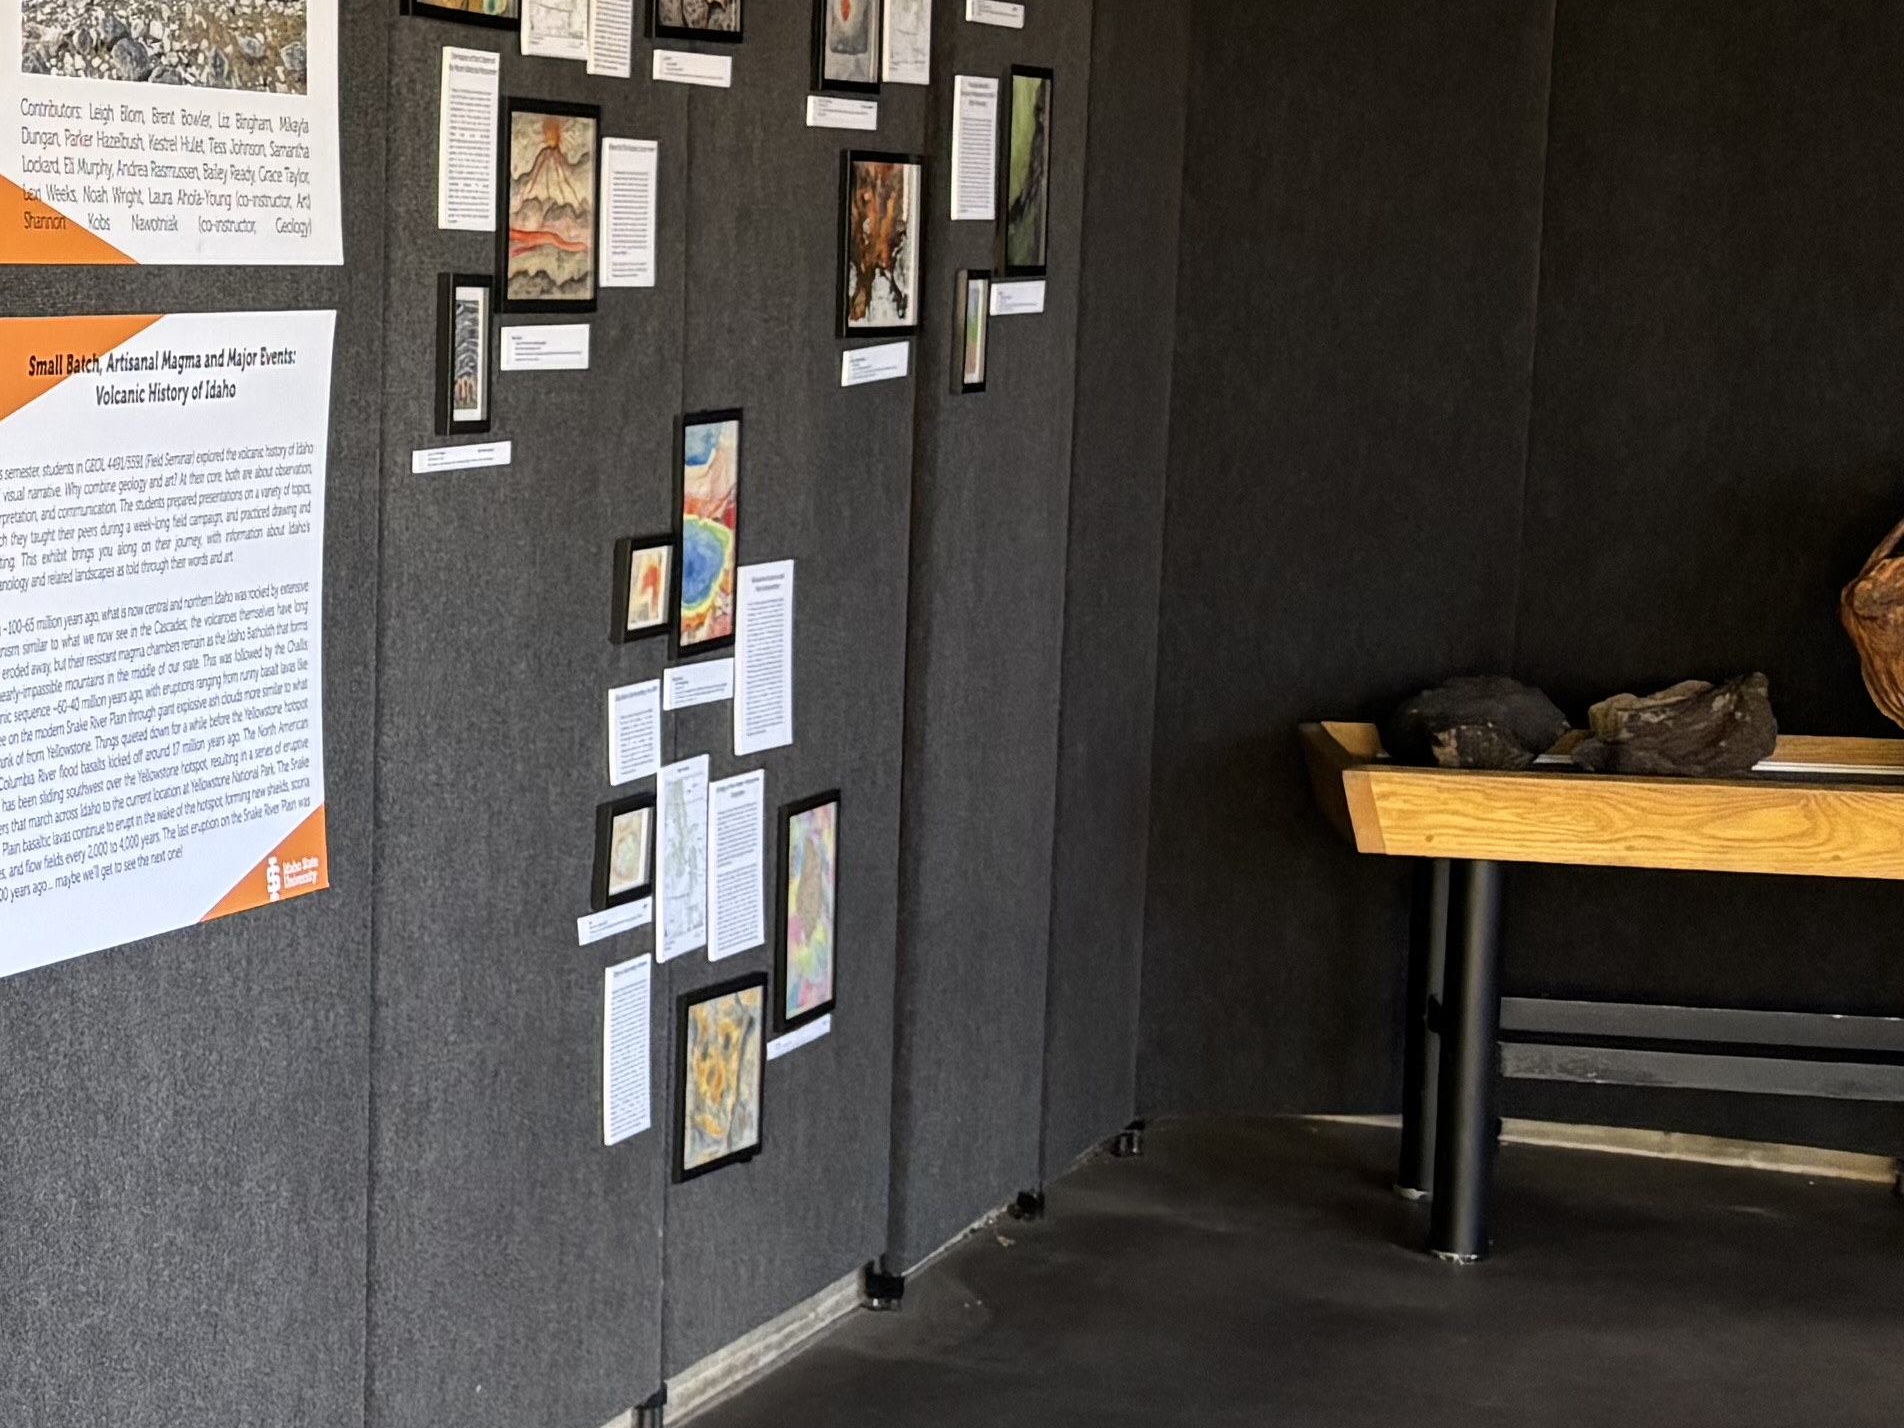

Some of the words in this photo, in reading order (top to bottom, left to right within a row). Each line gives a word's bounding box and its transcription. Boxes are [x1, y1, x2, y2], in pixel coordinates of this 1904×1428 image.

[28, 354, 62, 376] Small
[66, 350, 104, 375] Batch,
[105, 351, 158, 372] Artisanal
[160, 350, 201, 374] Magma
[203, 348, 224, 368] and
[226, 347, 257, 371] Major
[260, 346, 296, 365] Events:
[95, 384, 145, 405] Volcanic
[148, 382, 189, 405] History
[191, 380, 203, 400] of
[204, 379, 235, 399] Idaho
